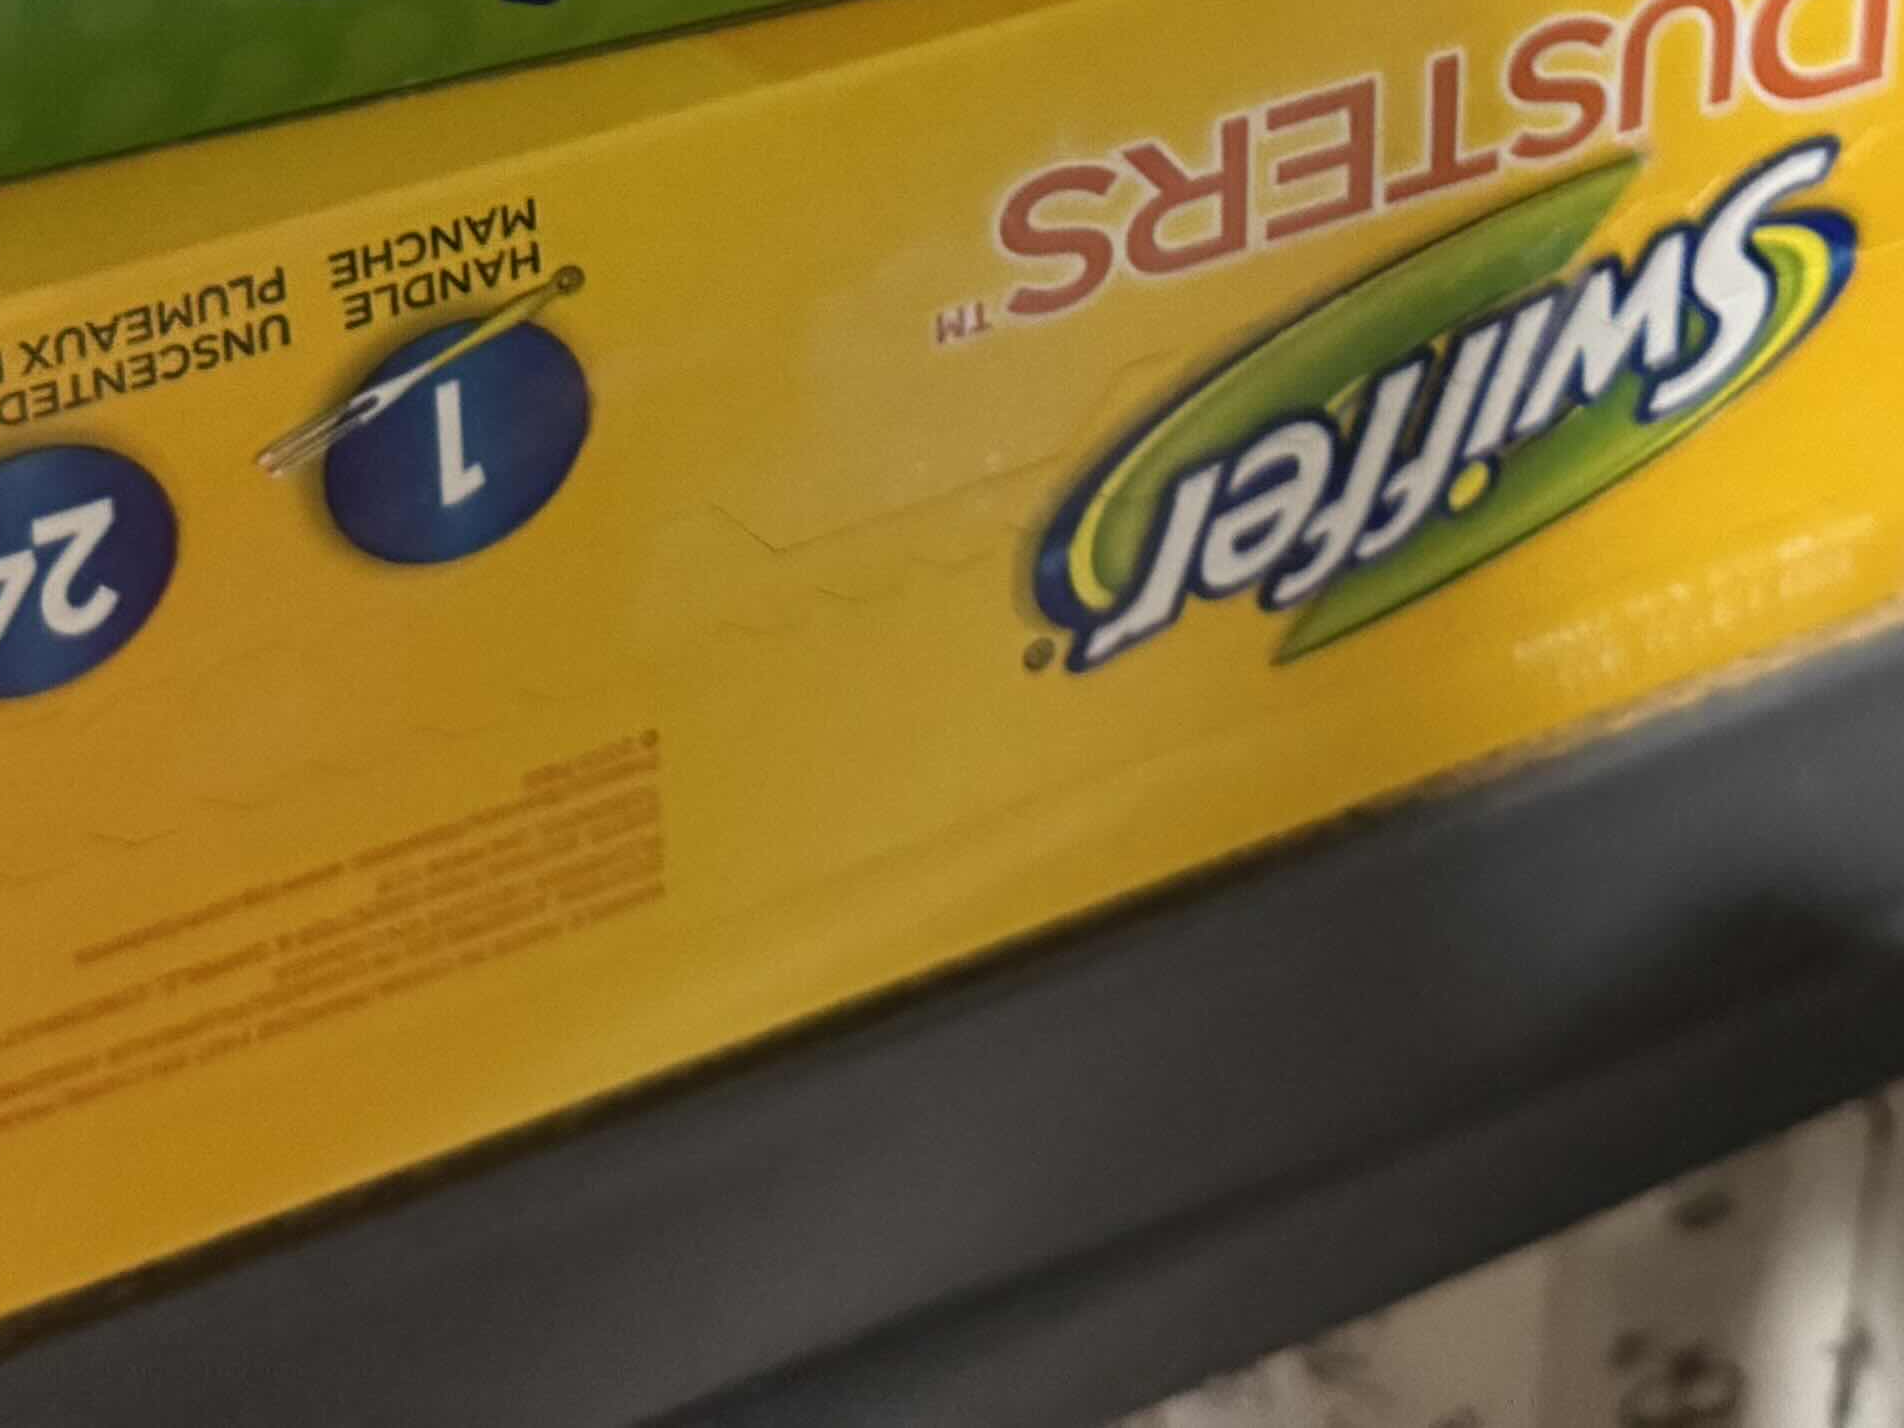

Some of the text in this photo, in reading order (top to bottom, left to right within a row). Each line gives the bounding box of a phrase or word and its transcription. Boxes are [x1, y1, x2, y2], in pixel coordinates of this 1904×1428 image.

[326, 198, 537, 289] MANCHE
[342, 243, 541, 328] HANDLE
[17, 268, 285, 375] PLUMEAUX
[431, 380, 485, 508] 1
